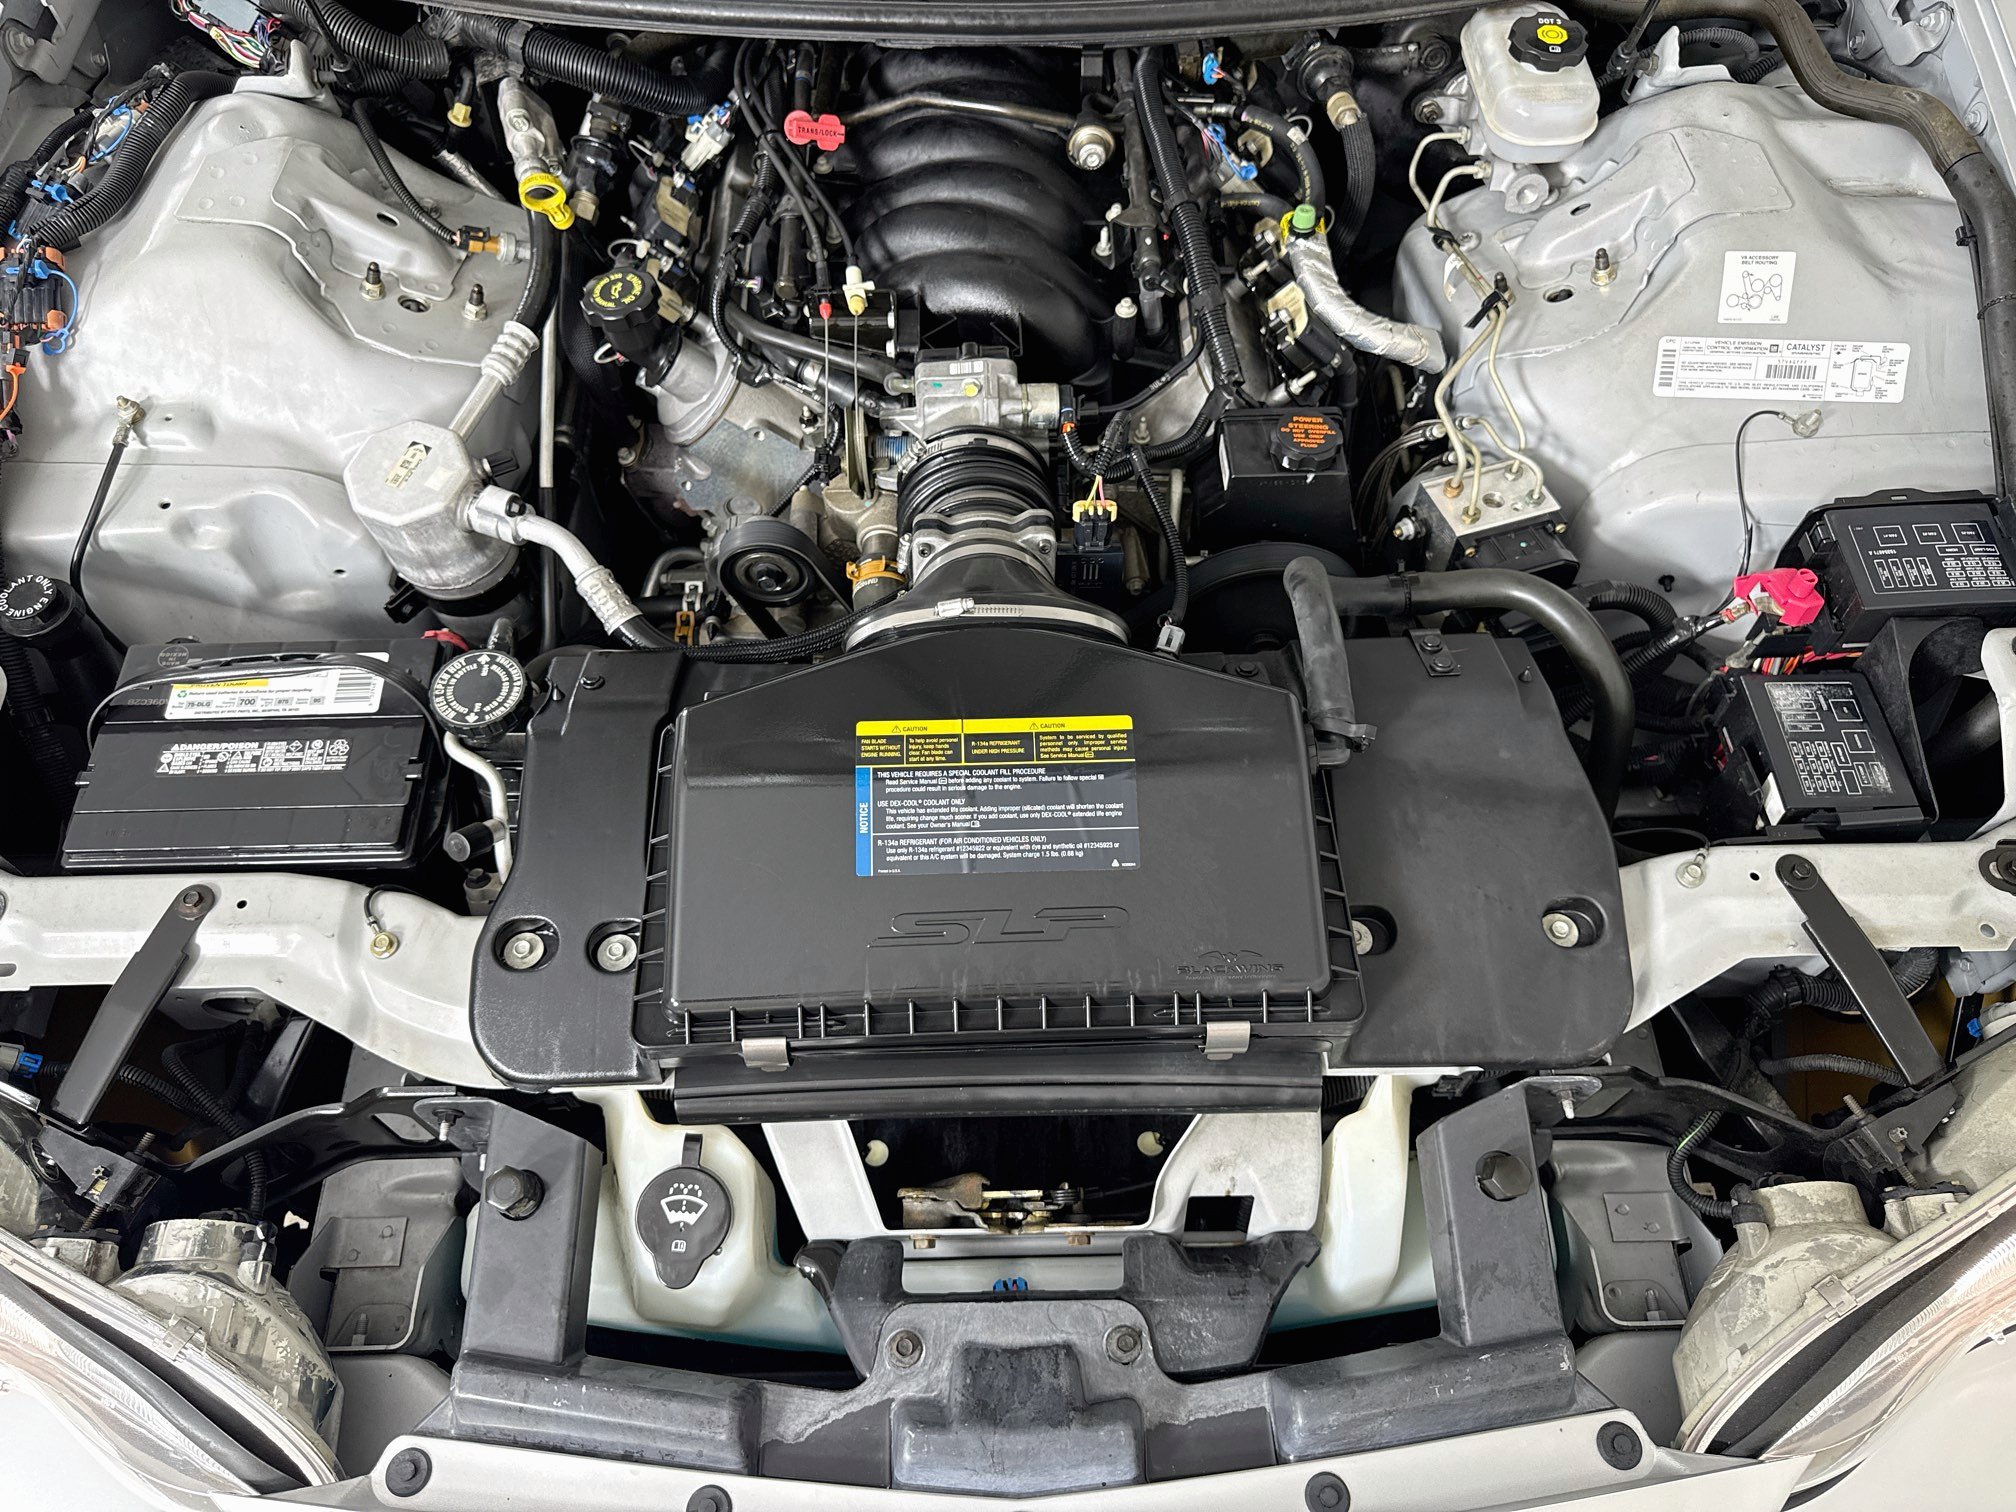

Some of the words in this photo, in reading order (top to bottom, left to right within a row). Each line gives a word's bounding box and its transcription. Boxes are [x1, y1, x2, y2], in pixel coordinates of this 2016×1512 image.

[798, 127, 837, 137] TRANS/LOCK
[1786, 343, 1825, 351] CATALYST
[0, 575, 33, 611] COOLANT
[36, 576, 53, 594] ONLY
[6, 597, 49, 617] ENGINE
[448, 659, 467, 674] HOT
[435, 673, 451, 694] OPEN
[436, 696, 457, 719] NEVER
[180, 742, 259, 750] DANGER/POISON
[860, 802, 868, 833] NOTICE
[1177, 964, 1284, 974] BLACKWING
